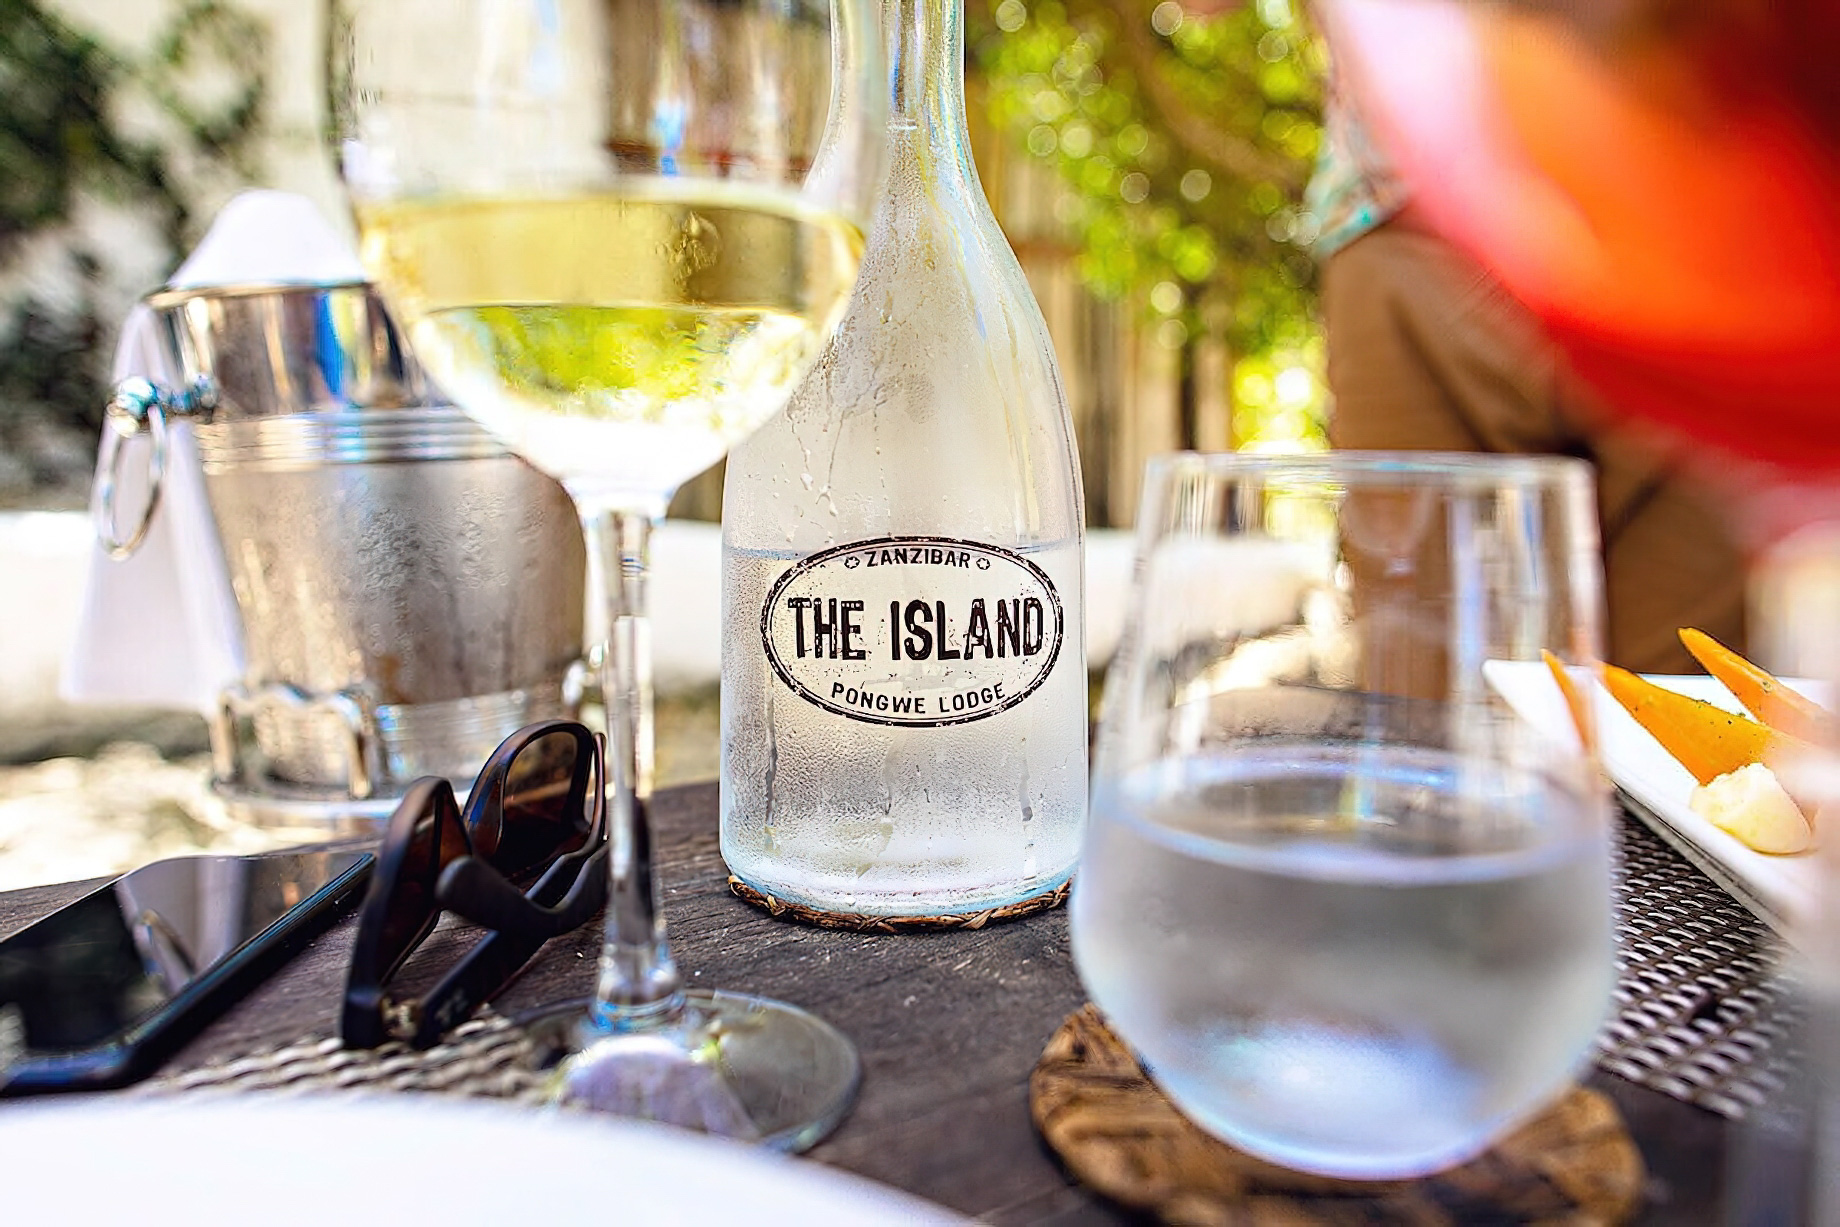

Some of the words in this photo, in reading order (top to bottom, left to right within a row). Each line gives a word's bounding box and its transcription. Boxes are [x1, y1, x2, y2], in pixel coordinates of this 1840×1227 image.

[866, 547, 971, 569] ZANZIBAR
[788, 598, 867, 660] THE
[890, 598, 1043, 660] ISLAND
[831, 682, 926, 714] PONGWE
[939, 682, 1006, 713] LODGE
